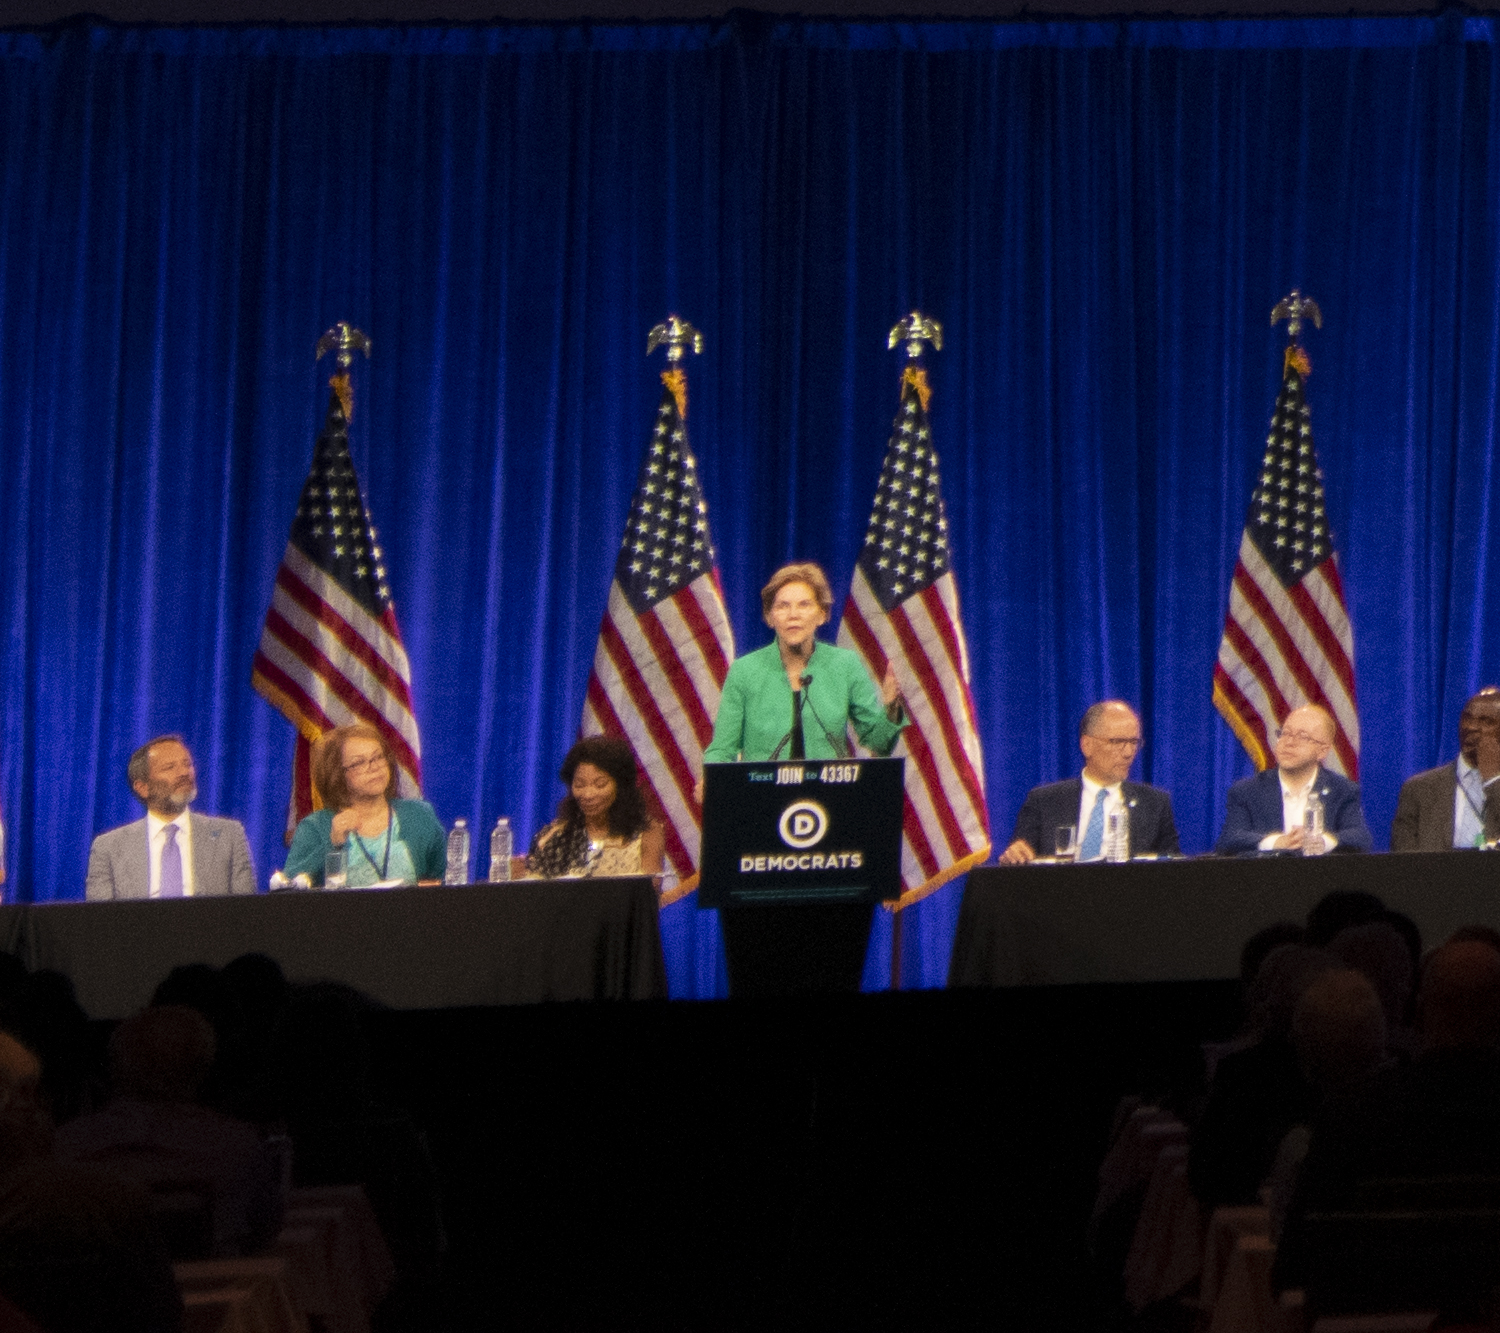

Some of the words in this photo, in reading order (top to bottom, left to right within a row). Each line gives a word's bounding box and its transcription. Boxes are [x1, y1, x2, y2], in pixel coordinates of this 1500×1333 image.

[750, 772, 774, 782] Text
[777, 766, 804, 784] JOIN
[806, 772, 818, 780] to
[820, 765, 861, 783] 43367
[740, 853, 862, 872] DEMOCRATS
